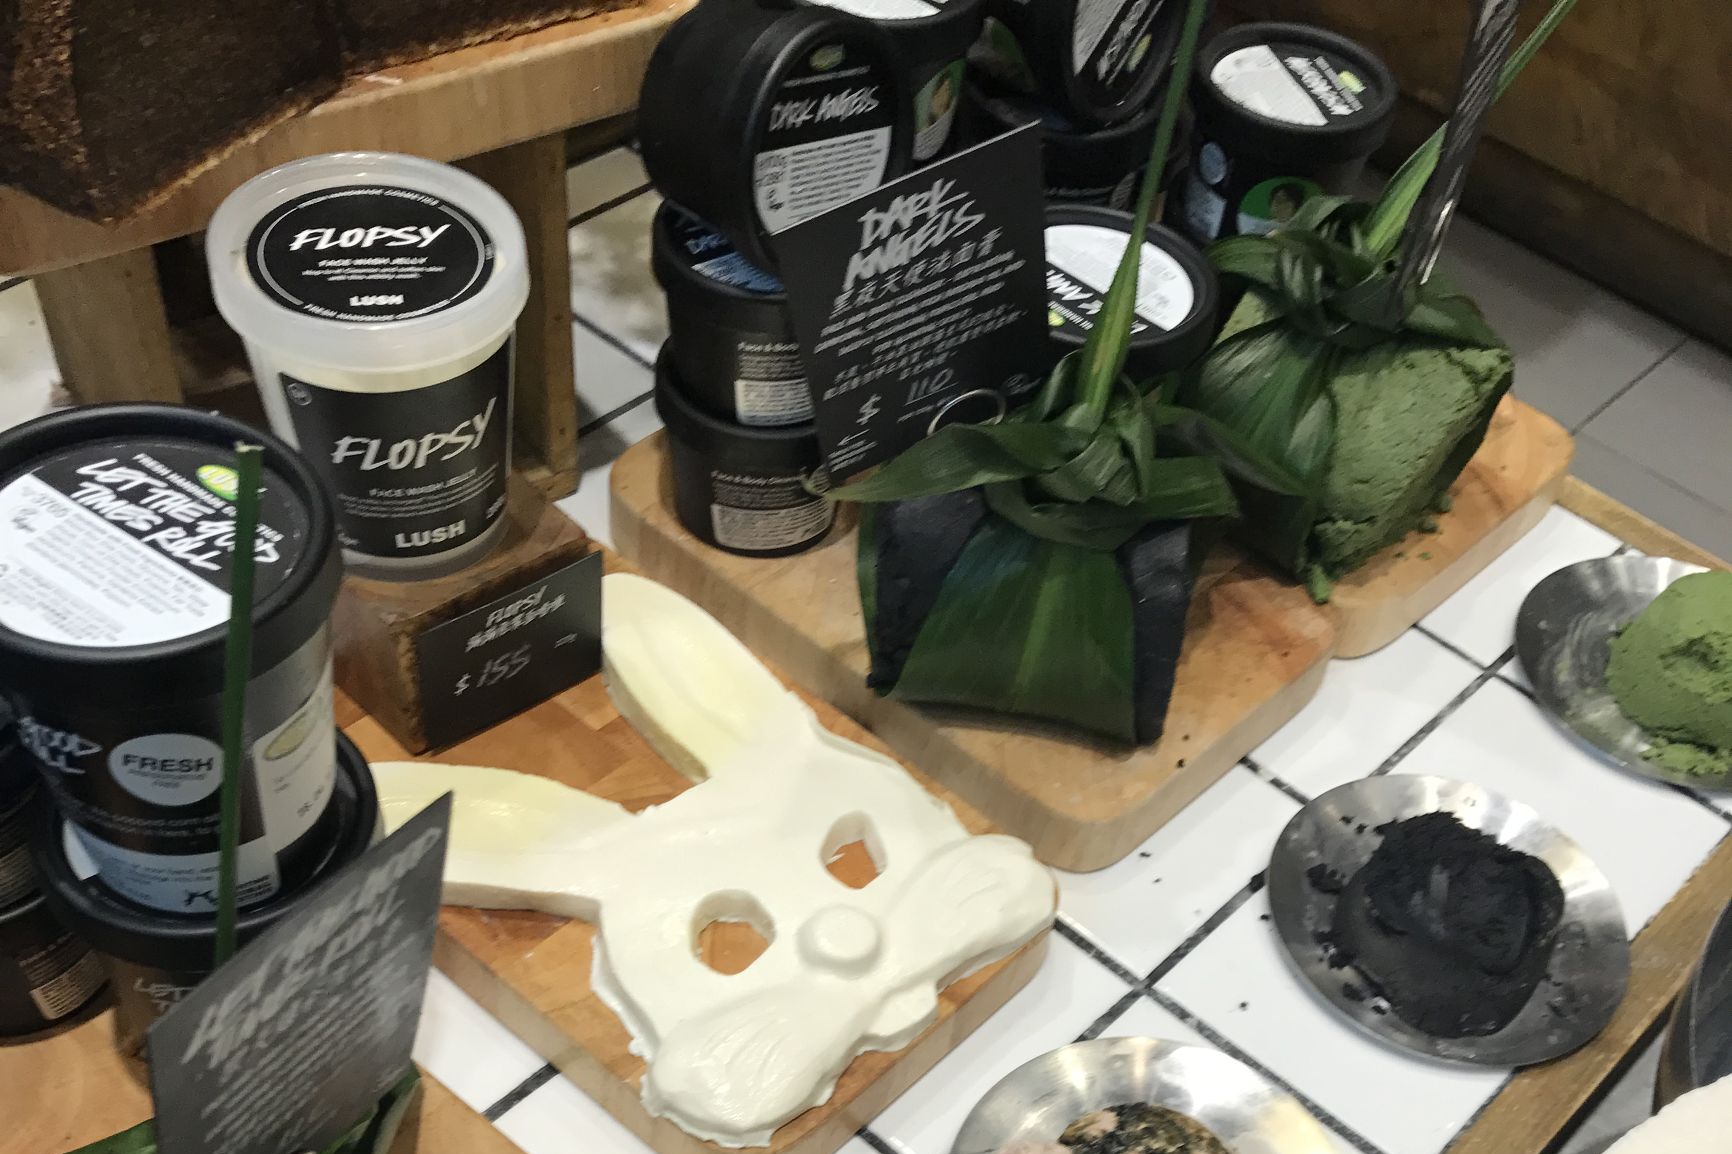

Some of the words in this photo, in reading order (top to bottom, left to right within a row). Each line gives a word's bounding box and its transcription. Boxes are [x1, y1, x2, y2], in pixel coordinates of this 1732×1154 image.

[289, 223, 451, 251] FLOPSY
[858, 178, 970, 251] DARK
[843, 199, 986, 292] ANGELS
[349, 294, 404, 306] LUSH
[331, 397, 496, 471] FLOPSY
[76, 458, 168, 492] LET
[140, 487, 217, 523] THE
[395, 520, 467, 548] LUSH
[121, 753, 214, 773] FRESH
